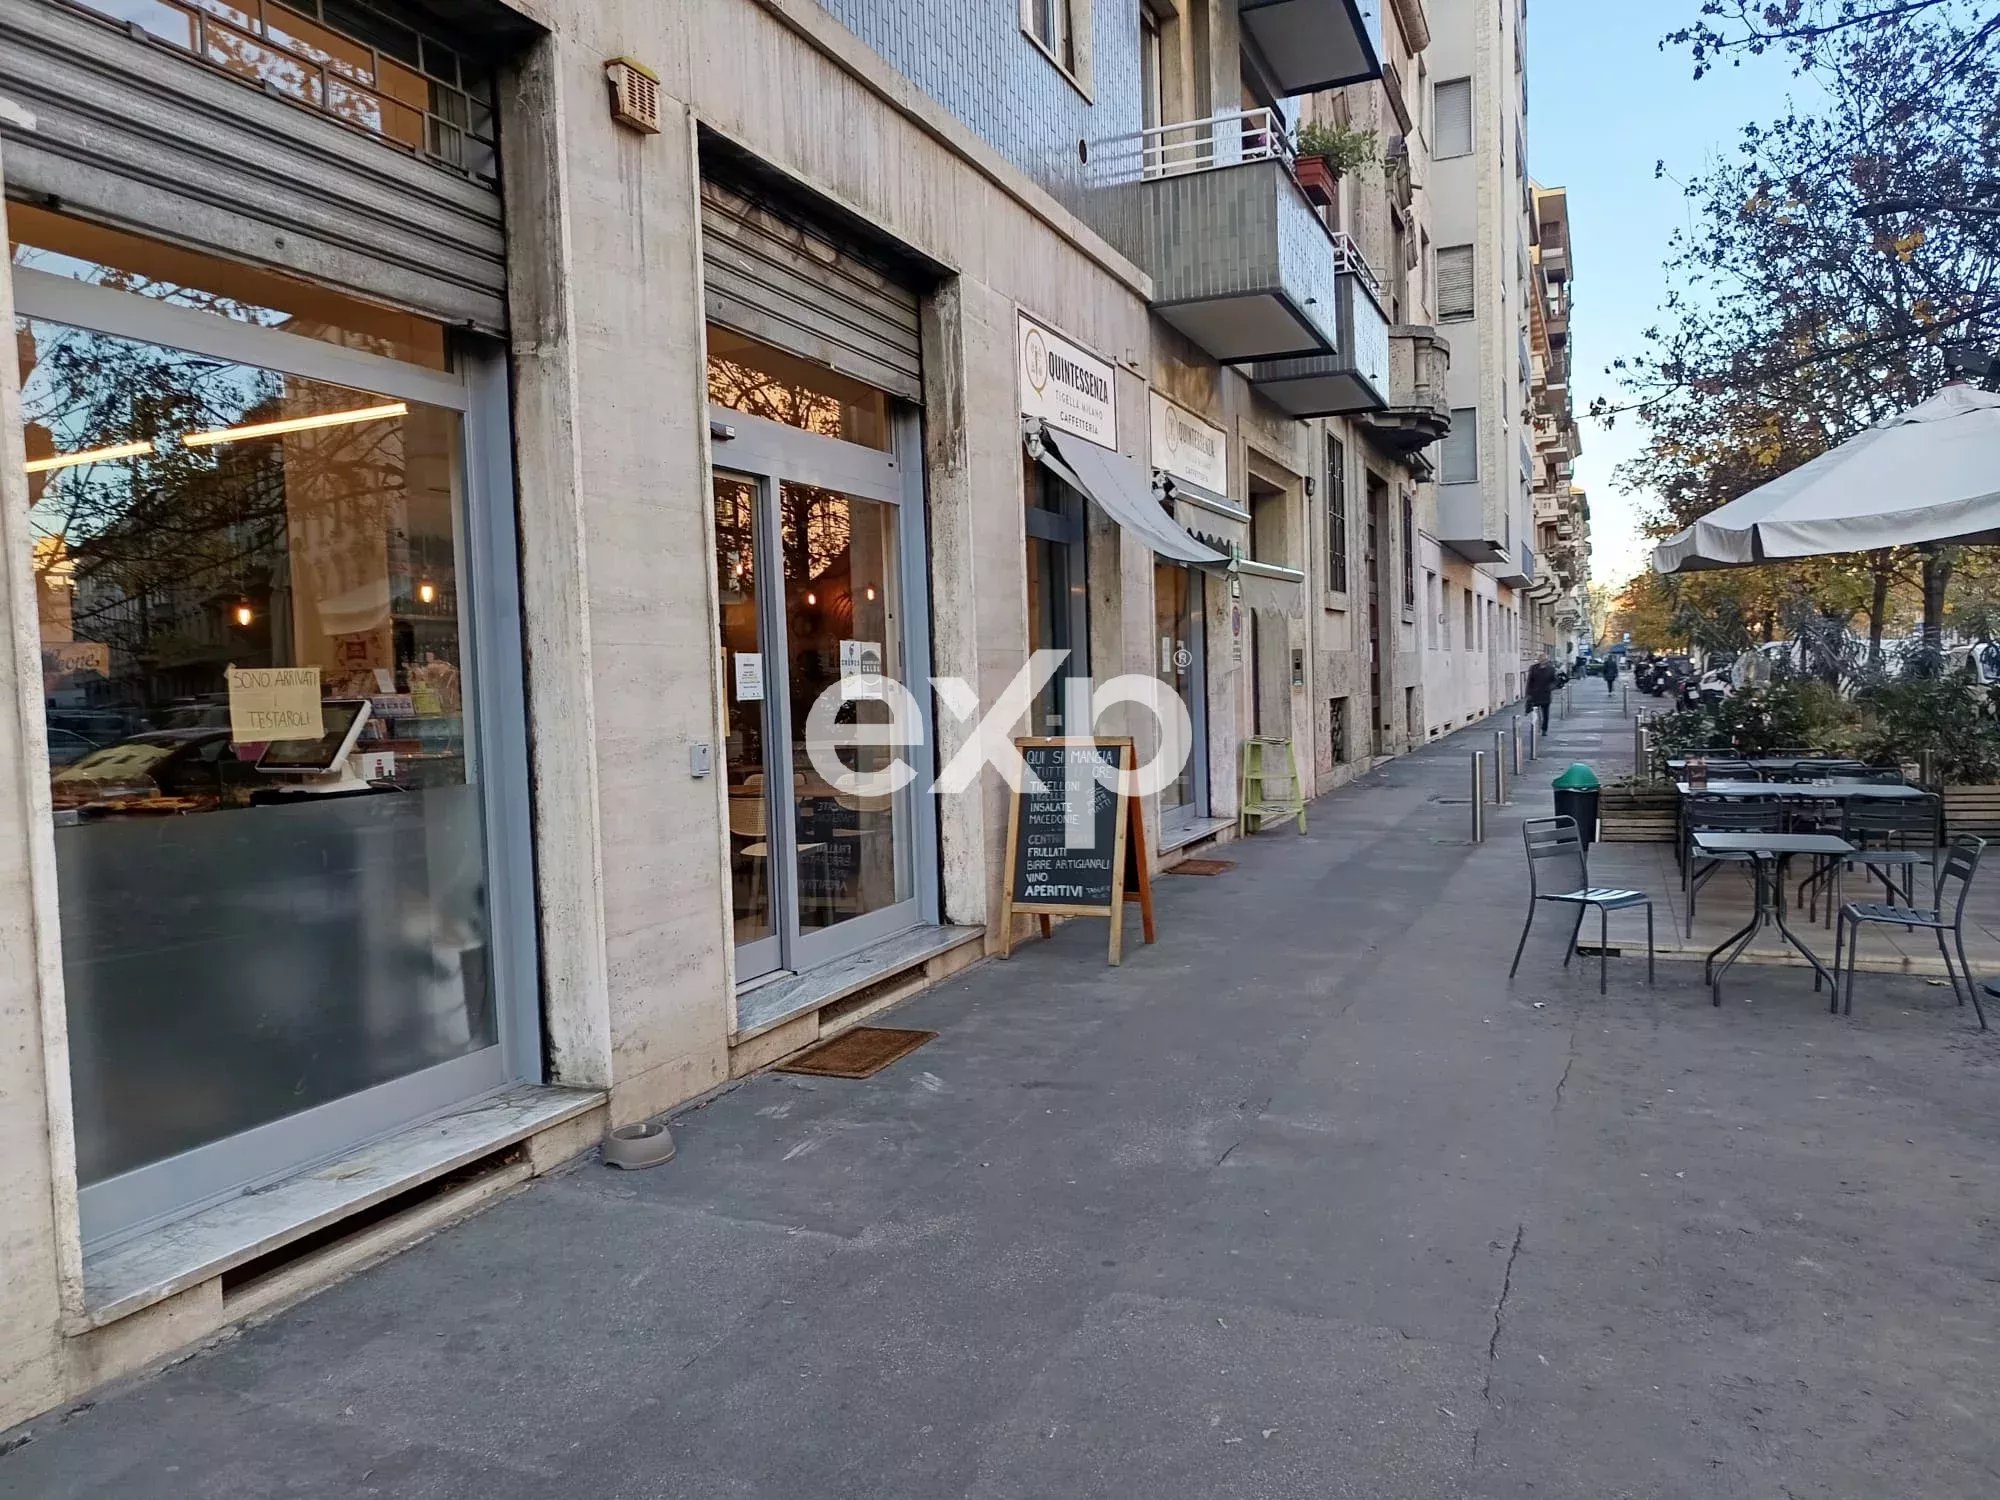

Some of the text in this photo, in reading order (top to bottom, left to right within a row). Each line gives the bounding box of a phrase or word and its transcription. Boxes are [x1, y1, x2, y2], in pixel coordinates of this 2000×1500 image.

[1049, 351, 1109, 405] QUINTESSENZA
[1055, 390, 1080, 409] TIGELLA
[1060, 411, 1099, 435] CAFFETTERIA
[234, 671, 318, 689] SONO ARRIVATI
[248, 710, 311, 729] TESTAROLI
[1026, 750, 1113, 765] QUI SI MANGIA
[1030, 781, 1080, 792] TIGELLONI
[1030, 802, 1073, 813] INSALATE
[1029, 814, 1080, 825] MACEDONIE
[1027, 847, 1067, 857] FRULLATI
[1027, 858, 1110, 871] BIRRE ARTIGIANALI
[1026, 872, 1049, 883] VINO
[1024, 884, 1083, 897] APERITIVI
